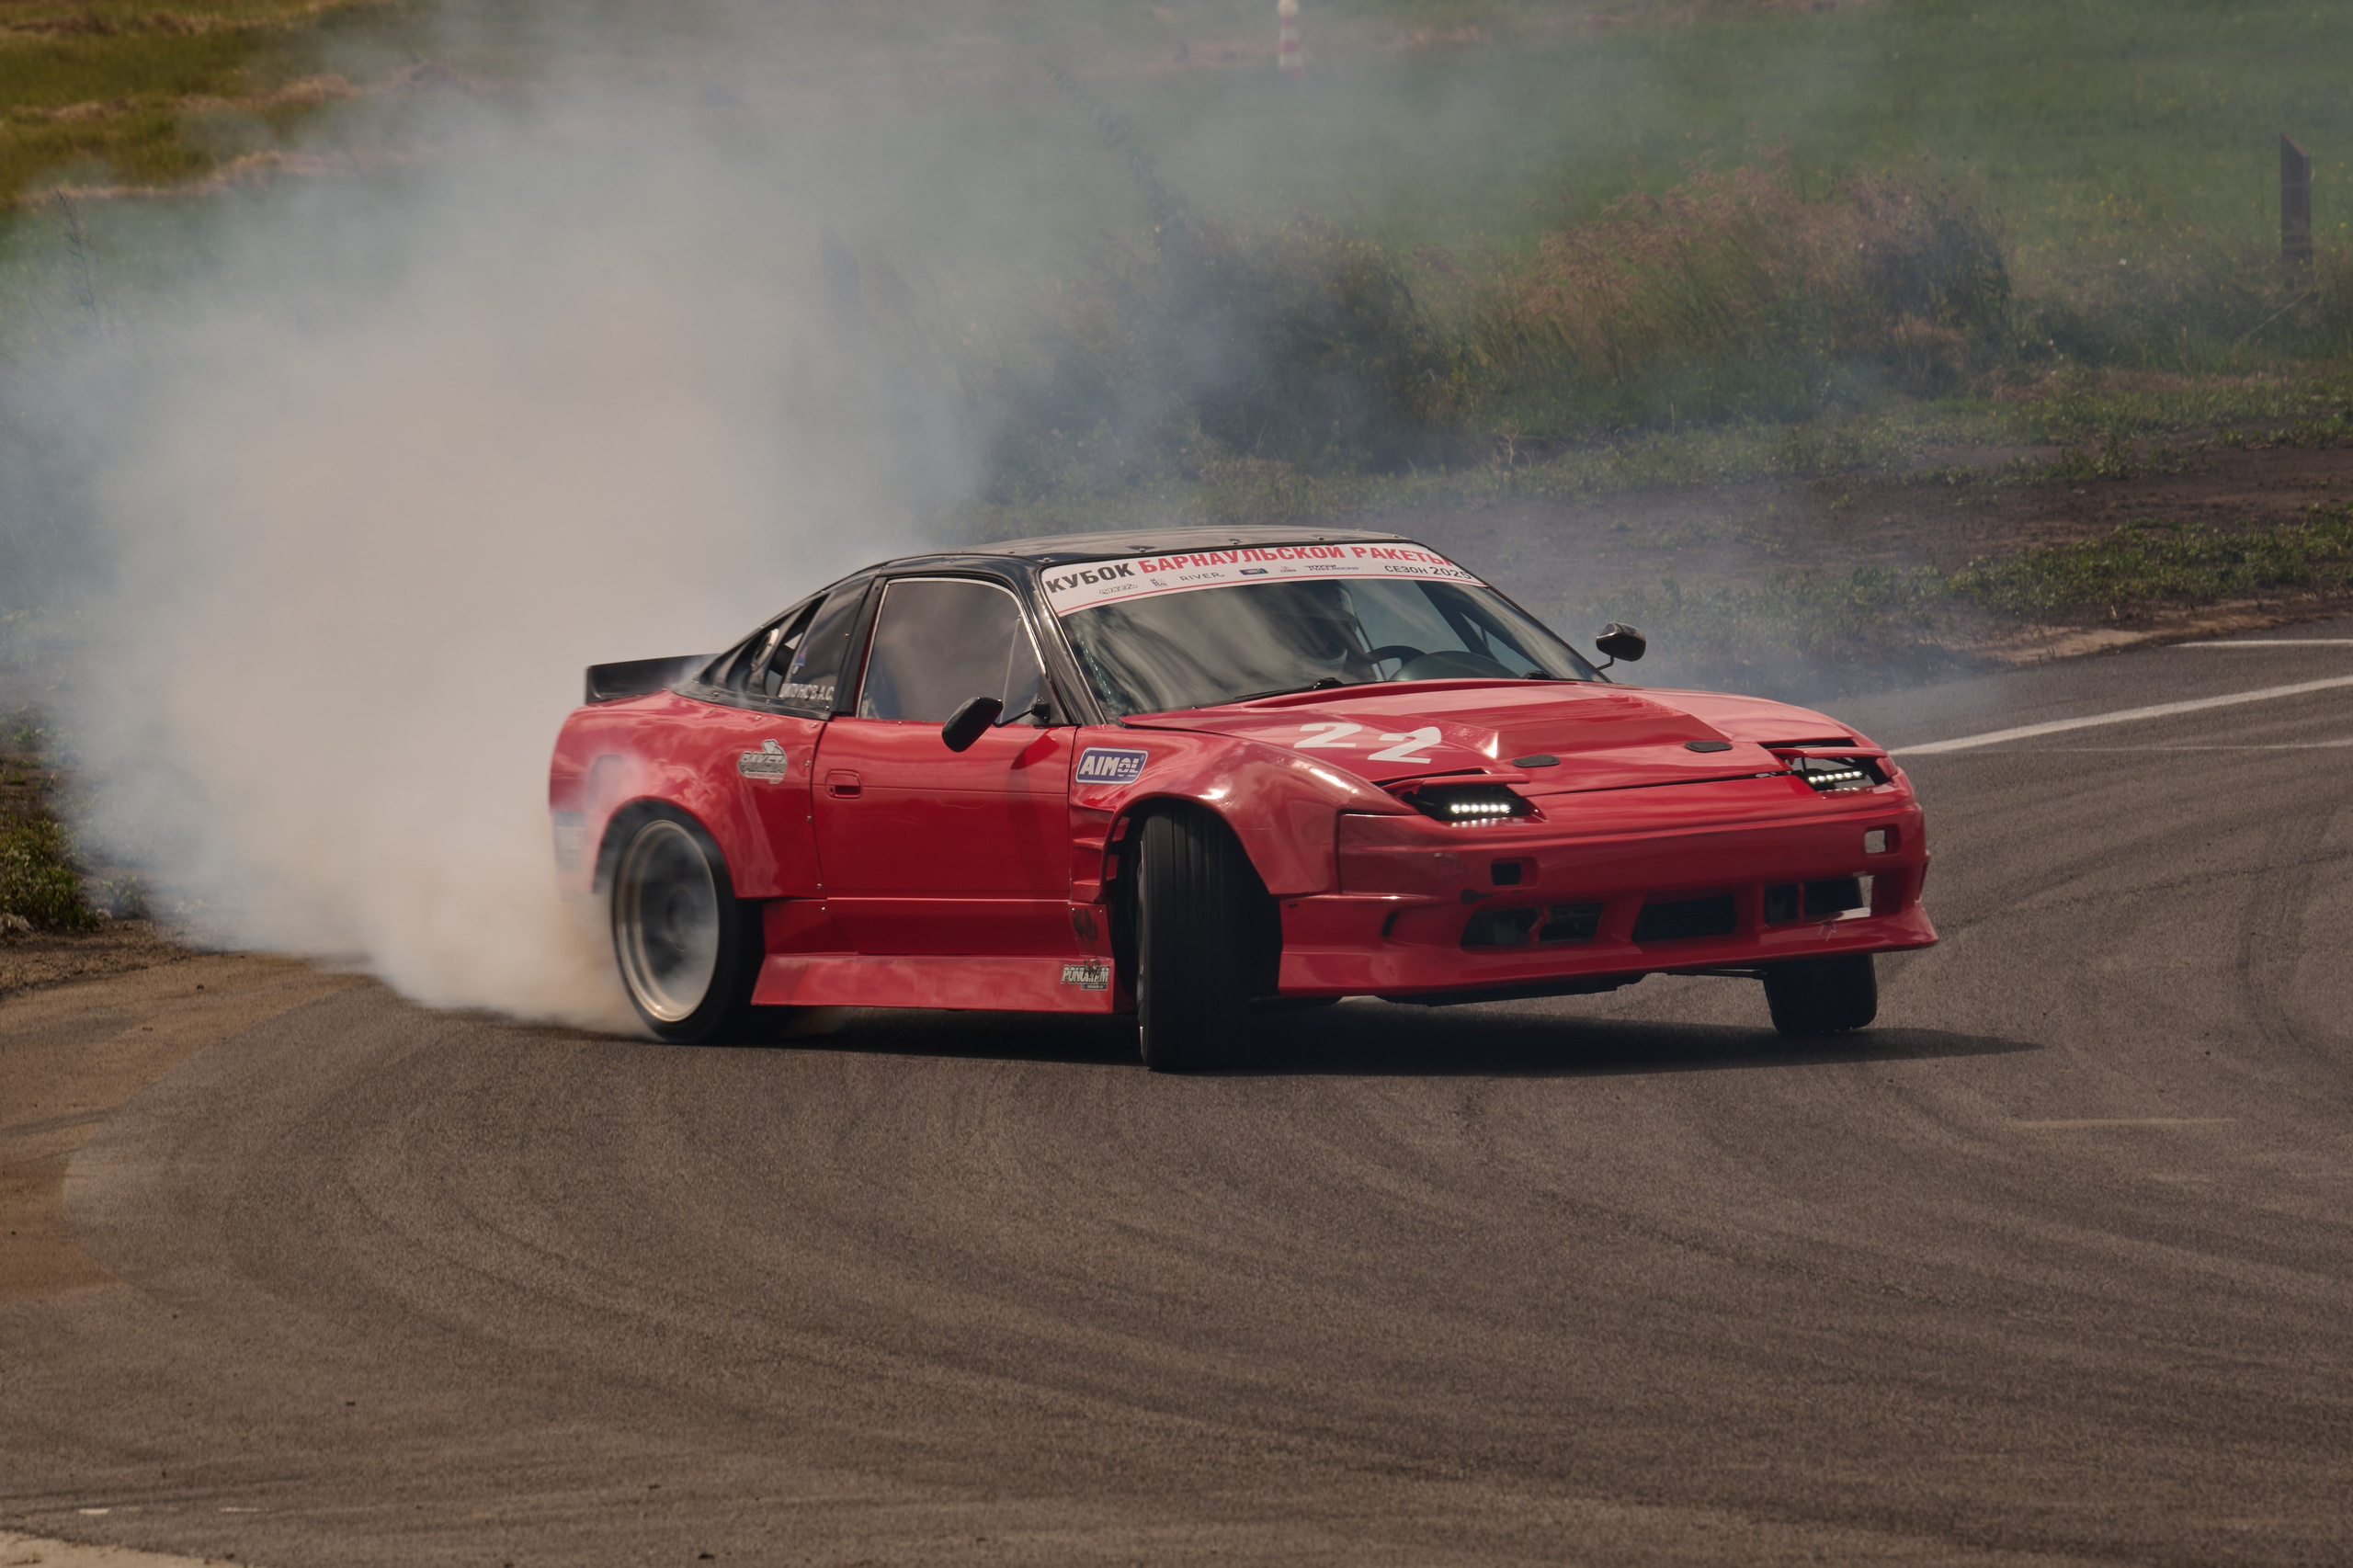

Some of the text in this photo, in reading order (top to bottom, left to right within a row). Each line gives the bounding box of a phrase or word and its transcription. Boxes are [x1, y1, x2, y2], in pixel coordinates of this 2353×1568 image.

[1045, 544, 1453, 594] КУБОК БАРНАУЛЬСКОЙ РАКЕТЫ
[1179, 572, 1225, 582] RIVER
[1384, 565, 1472, 580] СЕЗОН 2025
[1079, 756, 1140, 778] AIMOL
